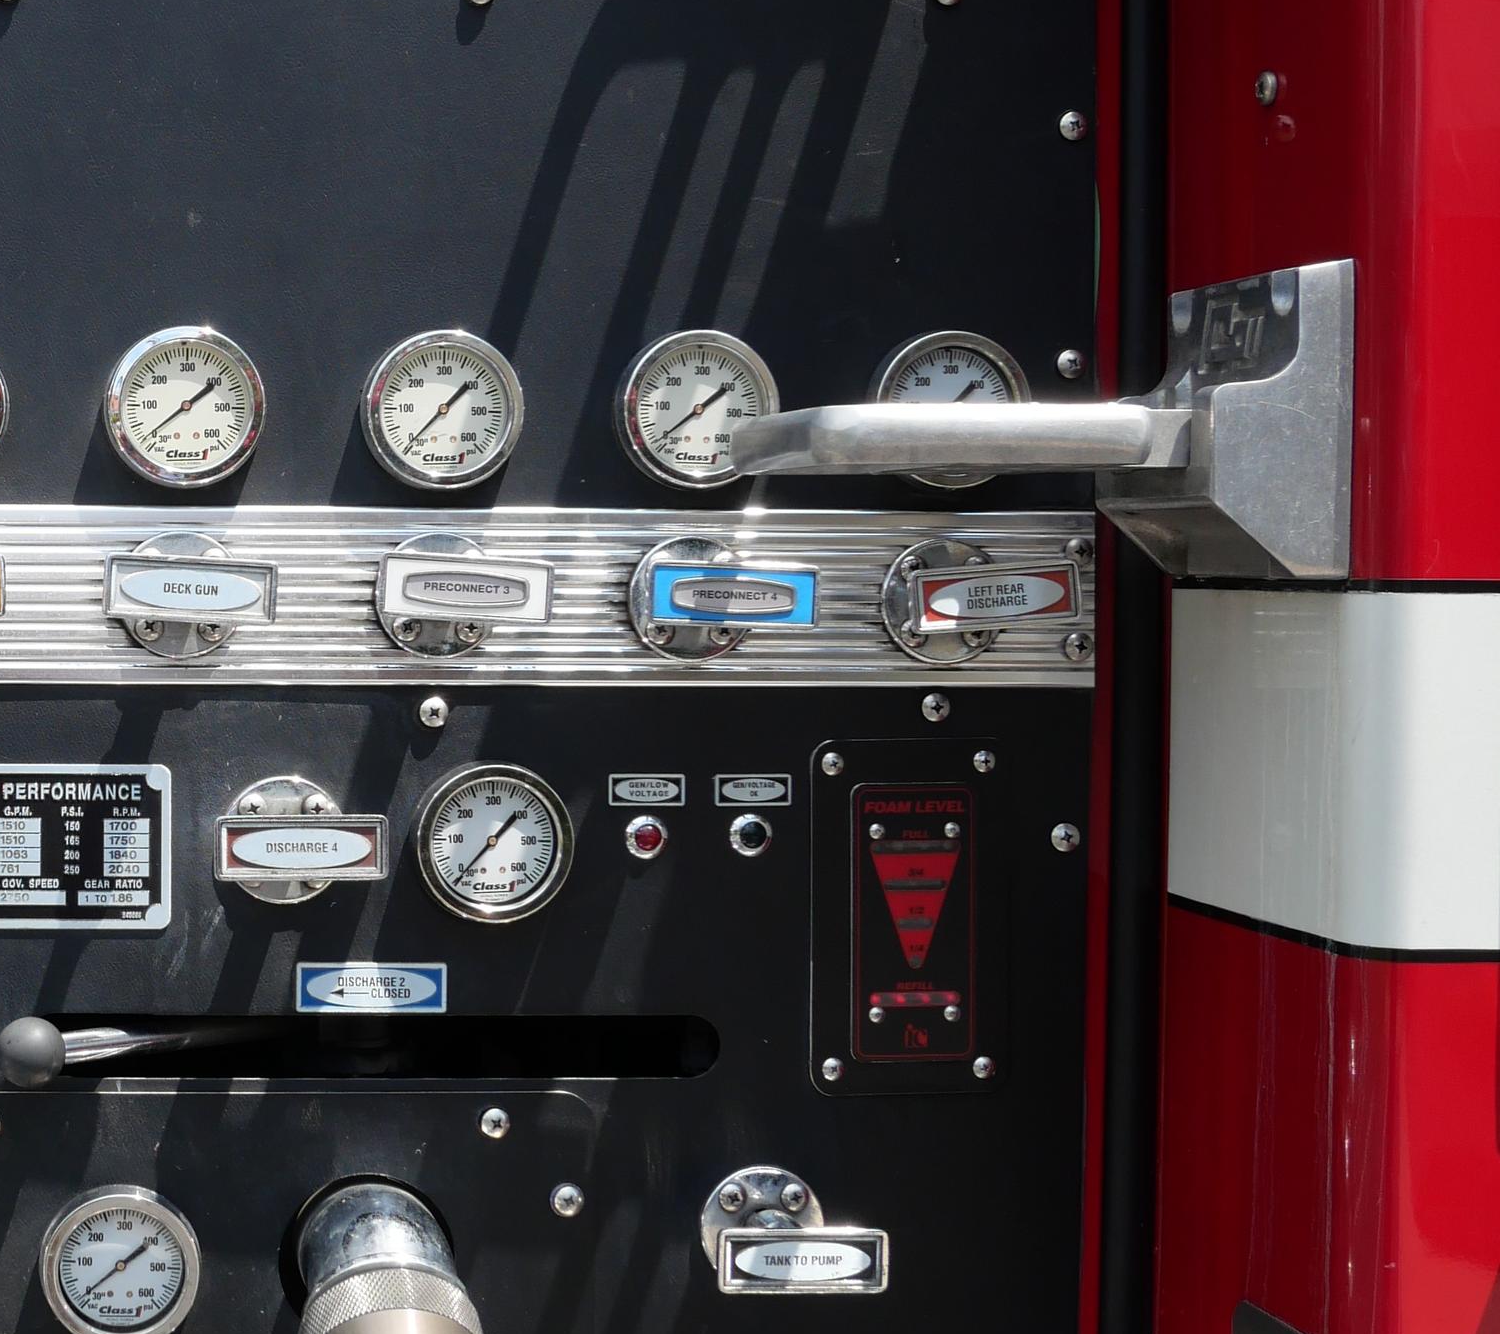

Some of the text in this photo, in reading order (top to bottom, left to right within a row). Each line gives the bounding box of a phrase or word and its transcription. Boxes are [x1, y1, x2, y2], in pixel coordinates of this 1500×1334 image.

[163, 582, 218, 596] DECK GUN
[423, 581, 510, 595] PRECONNECT 3
[968, 584, 1025, 598] LEFT REAR
[692, 589, 778, 601] PRECONNECT 4
[967, 595, 1029, 609] DISCHARGE
[628, 781, 669, 789] GEN/LOW
[2, 783, 142, 800] PERFORMANCE
[629, 789, 670, 797] VOLTAGE
[864, 801, 965, 814] FOAM LEVEL
[0, 821, 137, 831] 1510 1700
[0, 835, 26, 845] 1510
[109, 836, 137, 845] 1750
[266, 842, 338, 854] DISCHARGE 4
[28, 879, 59, 889] SPEED
[84, 879, 142, 889] GEAR RATIO
[338, 977, 405, 987] DISCHARGE 2
[371, 988, 411, 999] CLOSED
[764, 1256, 842, 1266] TANK TO PUMP
